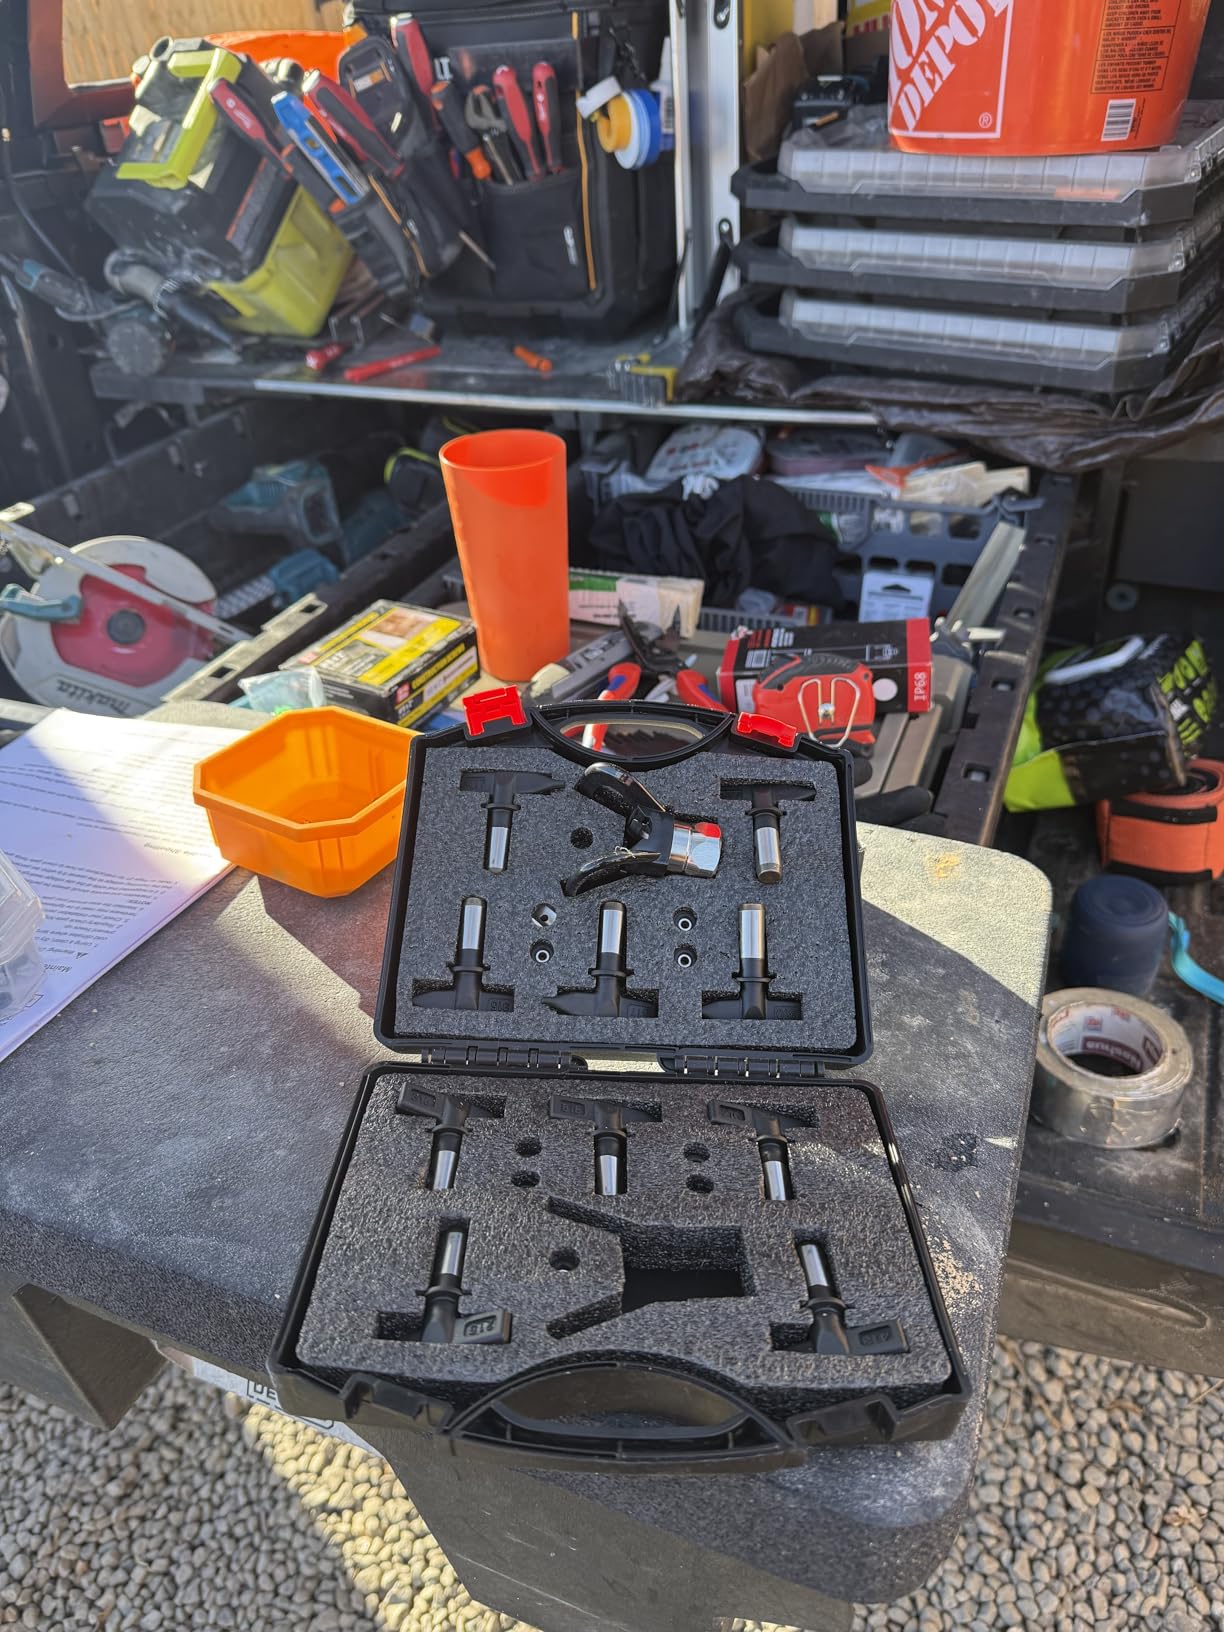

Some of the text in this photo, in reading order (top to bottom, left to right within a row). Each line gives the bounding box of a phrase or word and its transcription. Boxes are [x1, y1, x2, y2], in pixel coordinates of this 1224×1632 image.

[899, 0, 1007, 132] DEPO
[56, 679, 131, 715] makita
[913, 671, 927, 702] IP68
